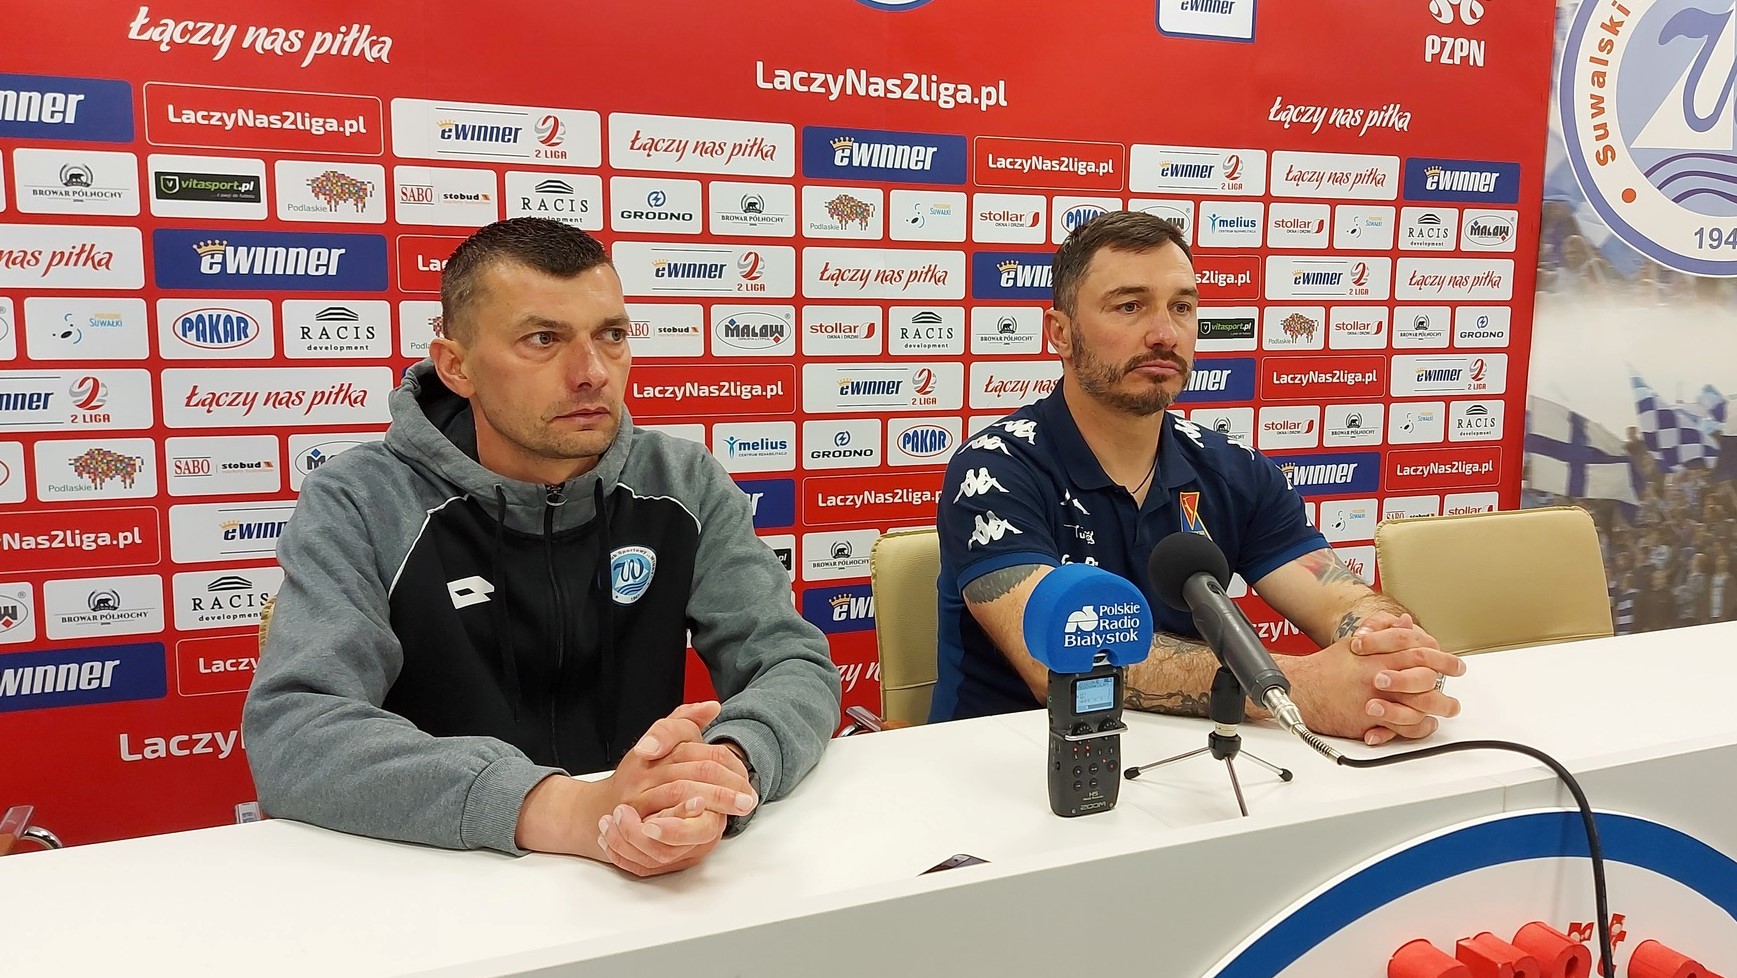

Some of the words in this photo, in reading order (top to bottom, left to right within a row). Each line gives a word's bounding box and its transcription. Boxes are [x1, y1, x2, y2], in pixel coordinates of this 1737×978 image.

[127, 5, 237, 61] Łączy
[241, 25, 304, 56] nas
[300, 23, 393, 67] piłka
[1425, 35, 1484, 67] PZPN
[755, 61, 1007, 111] LaczyNas2liga.pl
[1589, 1, 1631, 166] Suwalski
[167, 104, 367, 136] LaczyNas2liga.pl
[1268, 96, 1327, 134] Łączy
[1329, 106, 1362, 127] nas
[1359, 103, 1411, 136] piłka
[629, 130, 688, 163] Łączy
[693, 139, 726, 157] nas
[725, 135, 777, 165] piłka
[535, 150, 541, 158] 2
[545, 150, 567, 160] LIGA
[988, 153, 1113, 175] LaczyNas2liga.pl
[1285, 164, 1325, 190] Łączy
[1327, 171, 1351, 187] nas
[1349, 167, 1386, 191] piłka
[181, 178, 255, 192] vitasport.pl
[32, 189, 70, 198] BROWAR
[400, 186, 433, 203] SABO
[443, 192, 479, 201] stobud
[287, 203, 327, 213] Podlaskie
[522, 197, 588, 213] RACIS
[621, 211, 693, 221] GRODNO
[721, 214, 747, 222] BROWAR
[980, 210, 1025, 222] stollar
[1219, 216, 1256, 228] melius
[810, 223, 839, 231] Podlaskie
[1274, 218, 1311, 230] stollar
[1408, 227, 1449, 239] RACIS
[41, 243, 114, 277] piłka
[819, 262, 871, 289] Łączy
[875, 269, 903, 286] nas
[902, 263, 949, 291] piłka
[1408, 269, 1445, 293] Łączy
[1446, 275, 1469, 289] nas
[1467, 271, 1502, 293] piłka
[745, 283, 765, 291] LIGA
[181, 313, 249, 343] PAKAR
[301, 325, 375, 340] RACIS
[627, 322, 649, 337] ABO
[809, 322, 859, 334] stollar
[901, 326, 954, 339] RACIS
[1212, 322, 1252, 333] vitasport.pl
[1335, 321, 1371, 331] stollar
[1273, 370, 1377, 385] LaczyNas2liga.pl
[633, 380, 784, 401] LaczyNas2liga.pl
[984, 376, 1029, 397] Łączy
[185, 384, 257, 416] Łączy
[263, 393, 303, 409] nas
[303, 383, 367, 415] piłka
[71, 414, 79, 423] 2
[83, 413, 110, 423] LIGA
[1458, 417, 1496, 429] RACIS
[1264, 420, 1302, 431] stollar
[739, 439, 787, 452] melius
[902, 427, 946, 454] PAKAR
[811, 448, 873, 459] GRODNO
[174, 460, 210, 474] SABO
[222, 461, 260, 469] stobud
[1397, 459, 1493, 477] LaczyNas2liga.pl
[49, 484, 92, 493] Podlaskie
[1448, 505, 1482, 516] stollar
[192, 593, 270, 611] RACIS
[1100, 603, 1140, 616] Polskie
[62, 615, 98, 623] BROWAR
[1099, 617, 1140, 630] Radio
[1064, 631, 1139, 648] Białystok
[1080, 801, 1106, 811] ZOOM
